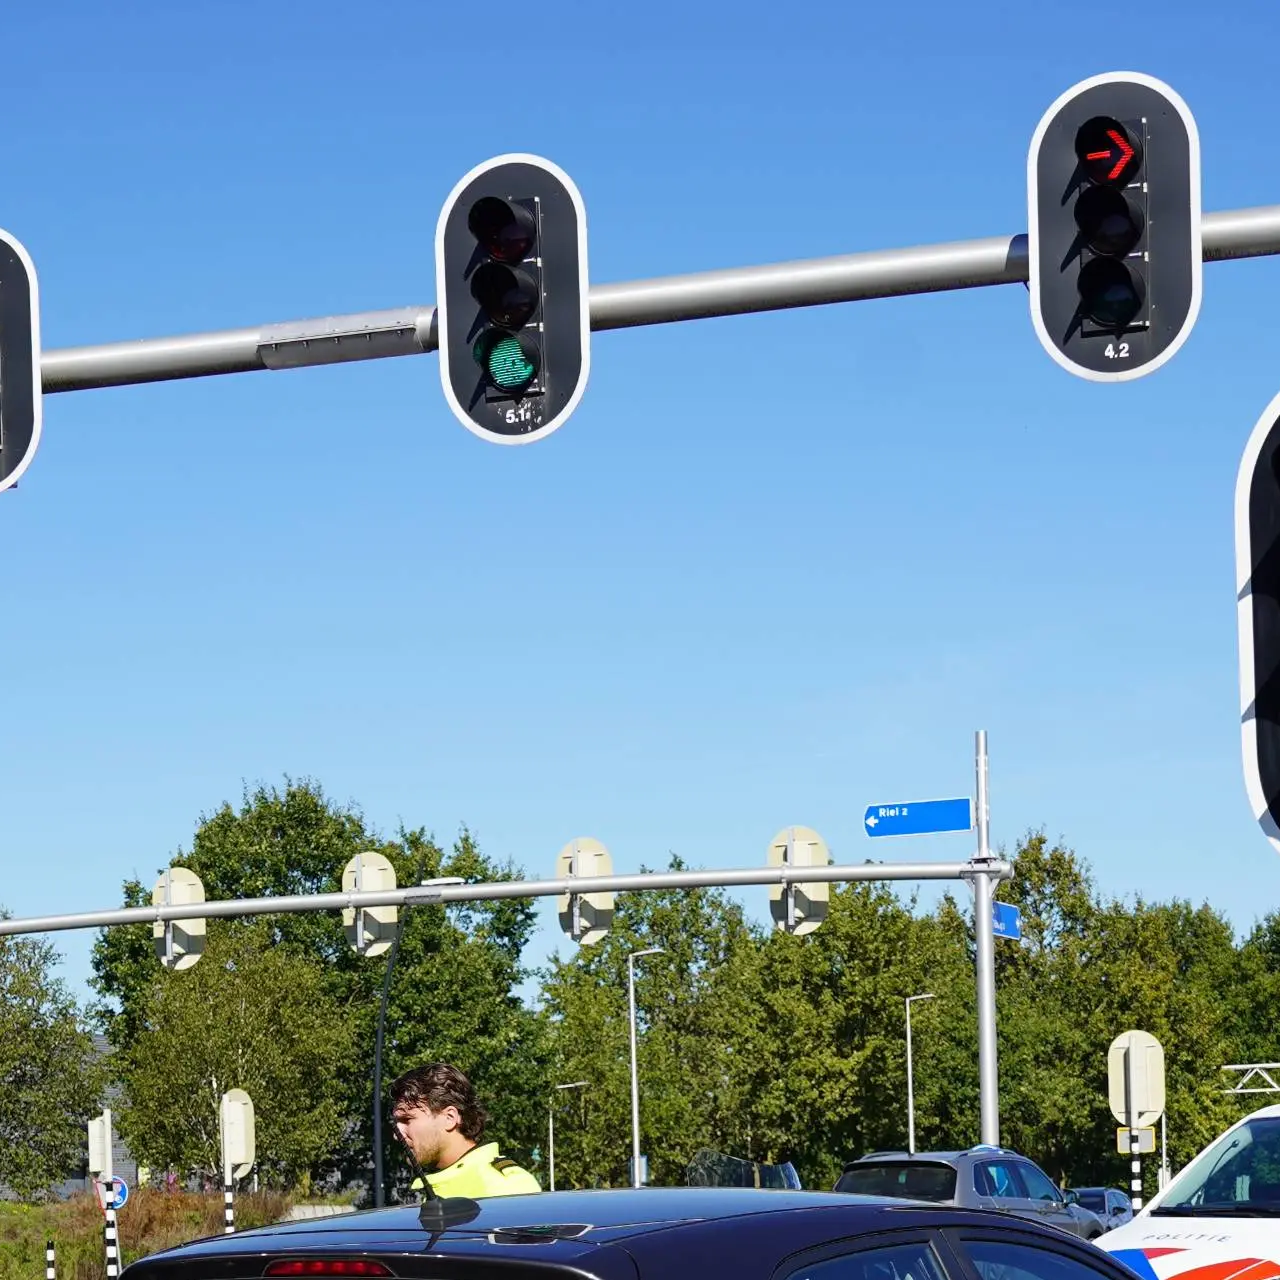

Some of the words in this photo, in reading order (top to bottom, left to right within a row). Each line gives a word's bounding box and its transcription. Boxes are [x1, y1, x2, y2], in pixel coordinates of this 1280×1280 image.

[1104, 342, 1129, 358] 4.2
[505, 408, 525, 423] 5.1
[878, 807, 899, 817] Riel
[901, 807, 908, 816] 2
